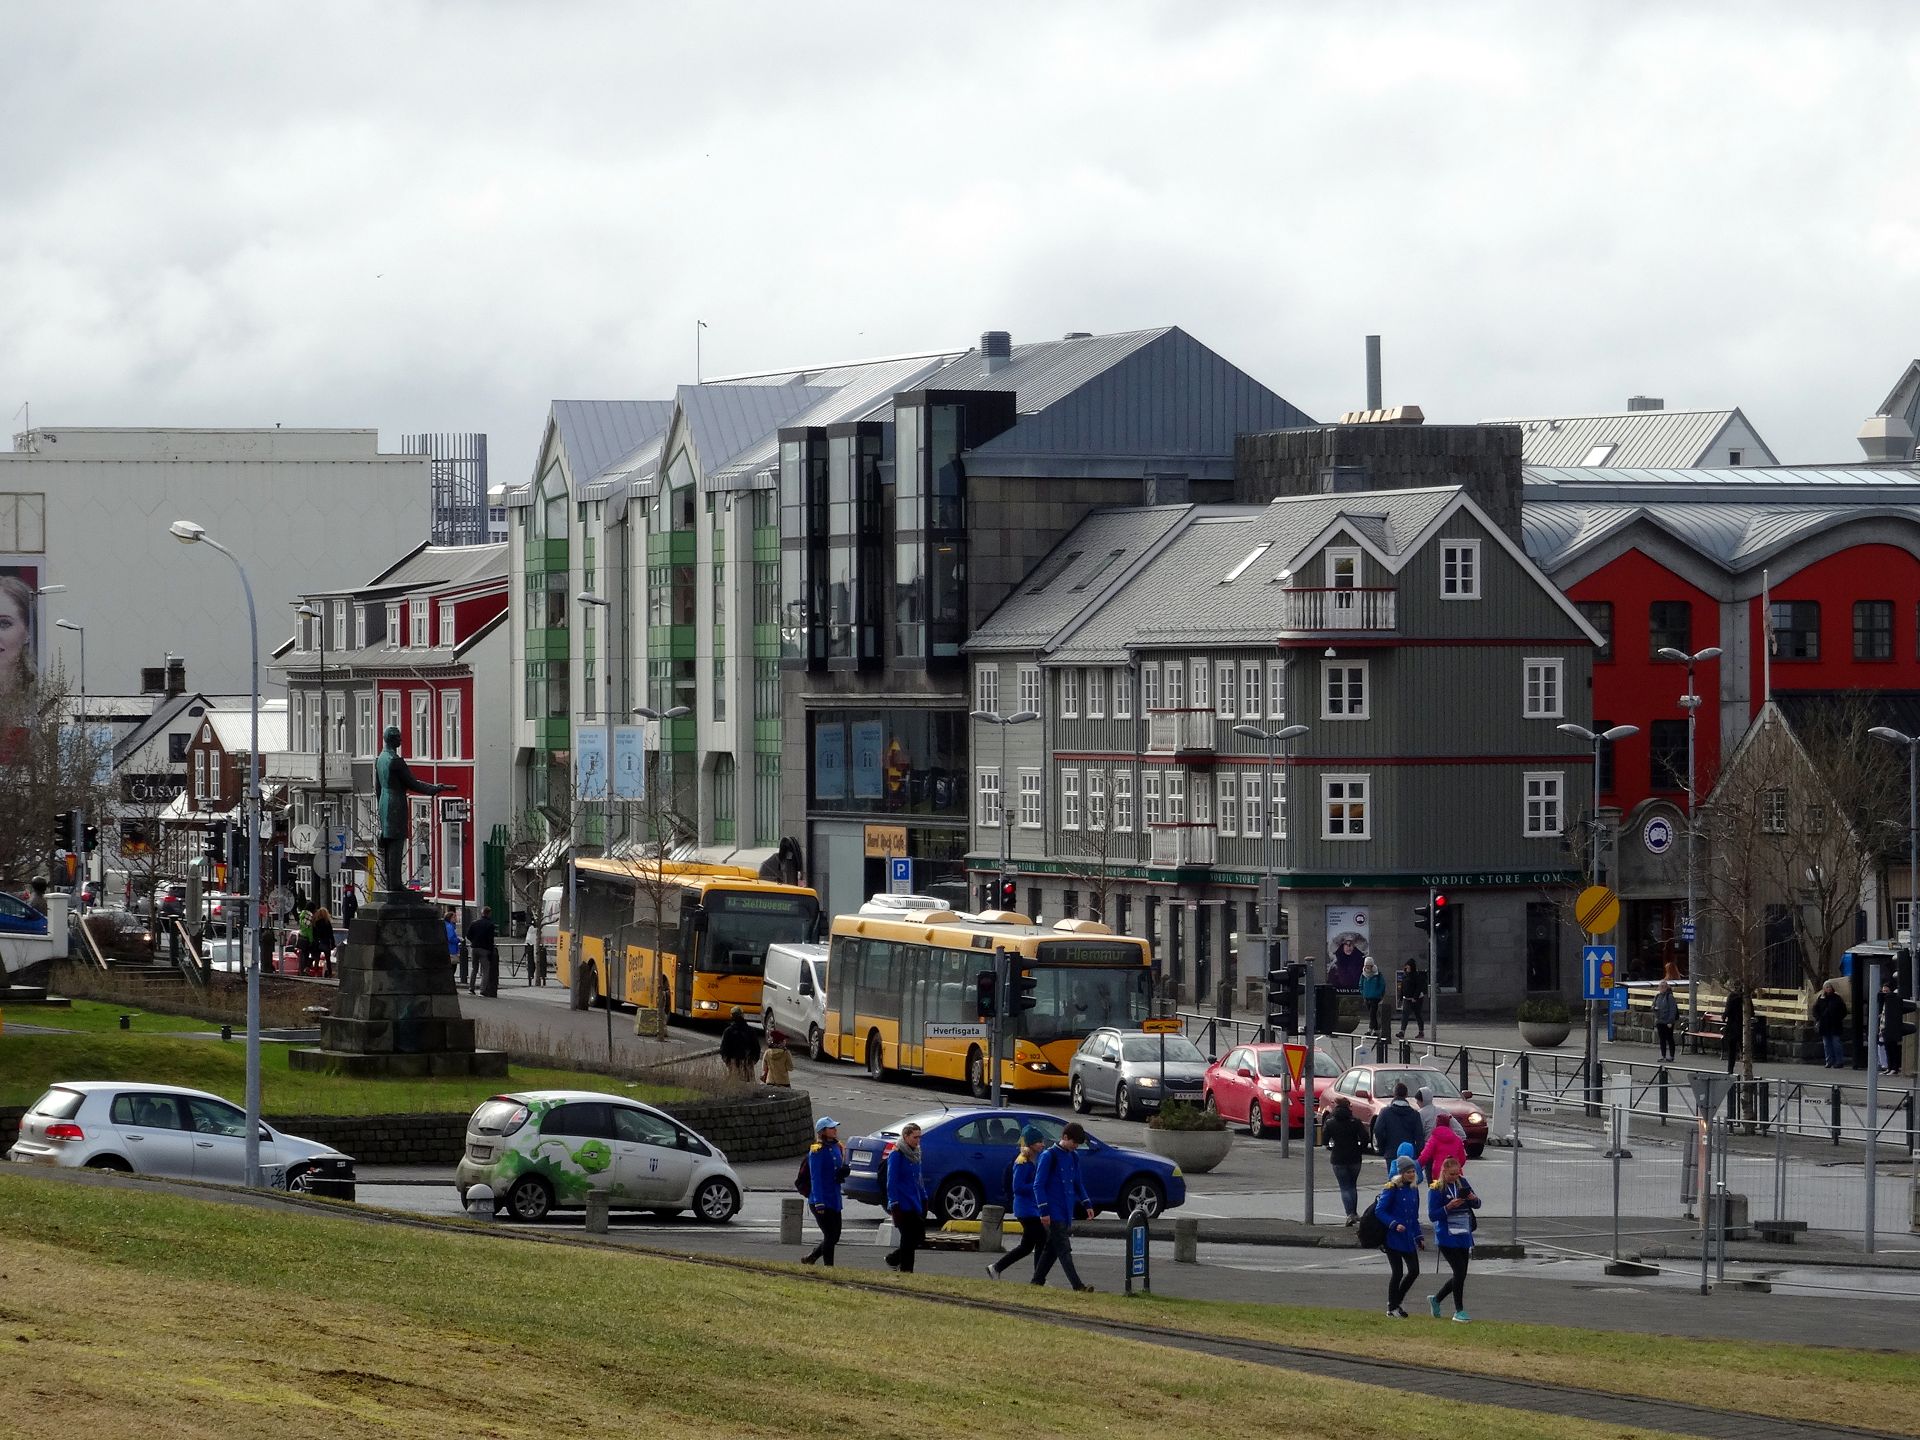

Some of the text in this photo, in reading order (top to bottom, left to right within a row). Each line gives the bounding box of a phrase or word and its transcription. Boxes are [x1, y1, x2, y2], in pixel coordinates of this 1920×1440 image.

[897, 863, 906, 877] P
[1134, 869, 1149, 877] STOR
[1210, 873, 1255, 884] NORDIC STORE
[1422, 875, 1473, 885] NORDIC
[1479, 874, 1520, 884] STORE
[933, 1027, 980, 1036] Hverfisgata
